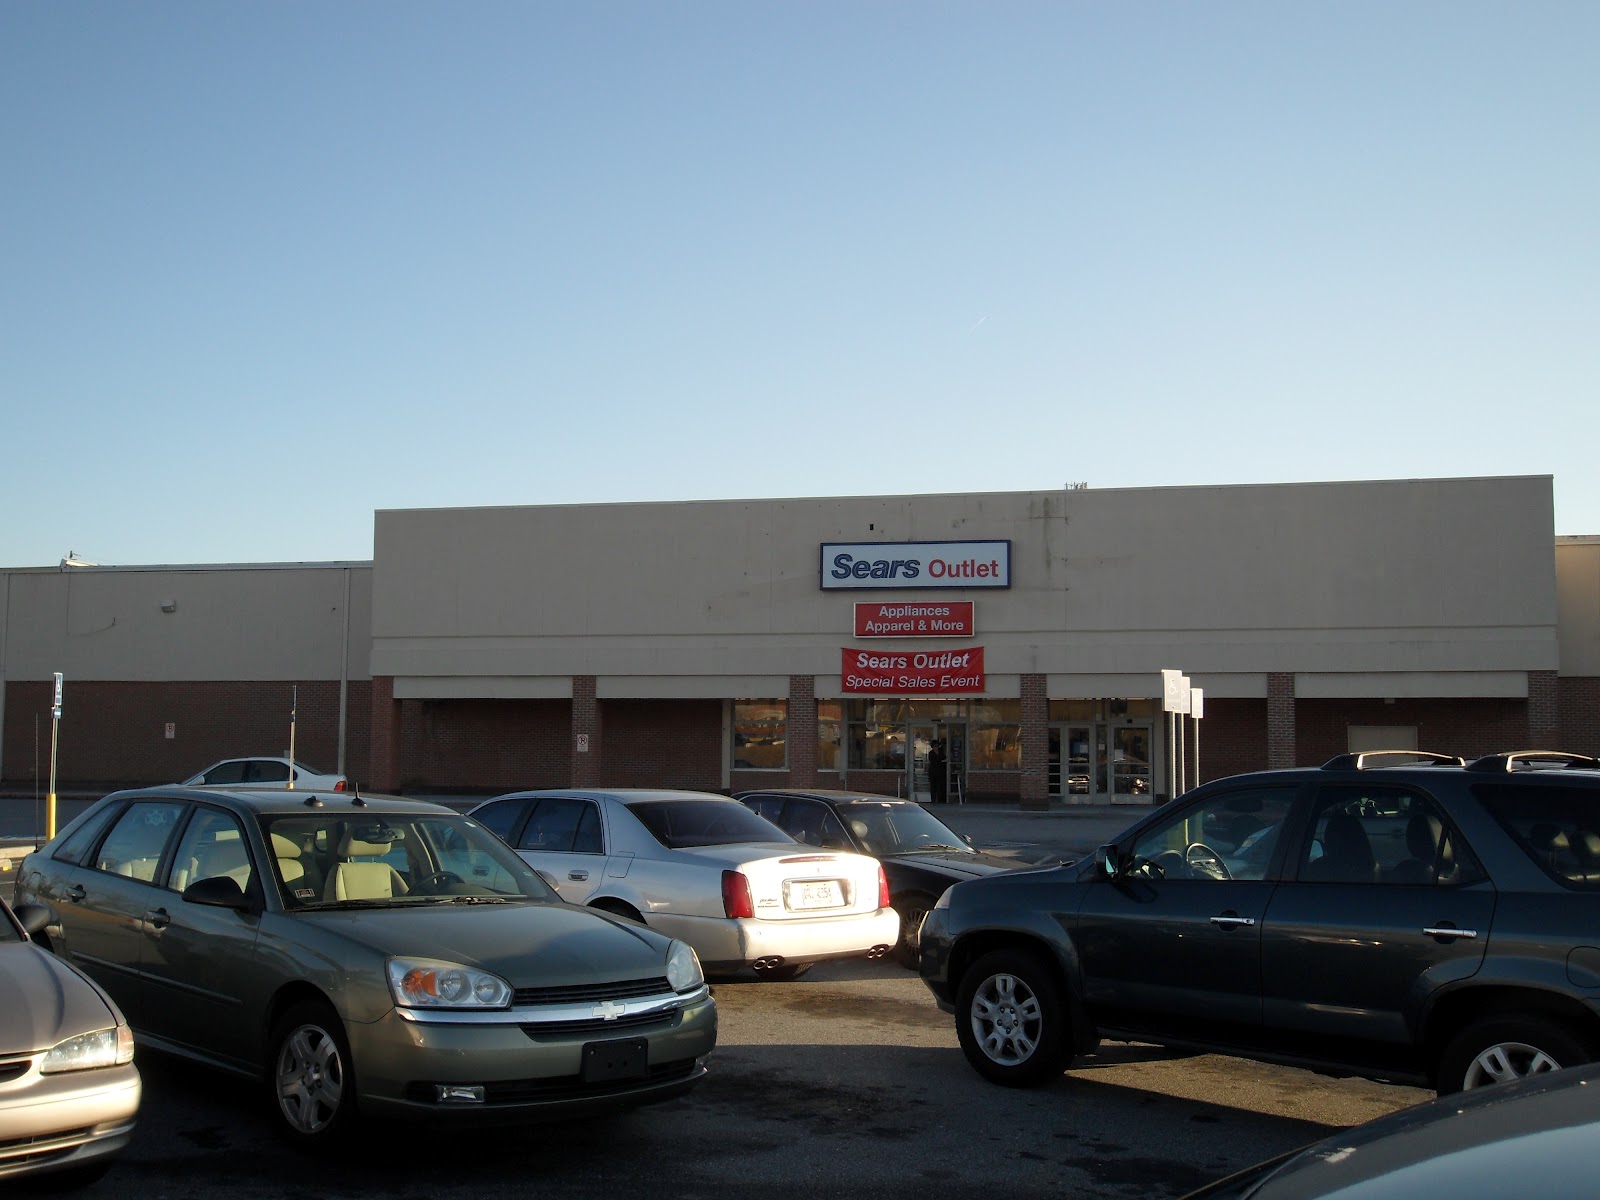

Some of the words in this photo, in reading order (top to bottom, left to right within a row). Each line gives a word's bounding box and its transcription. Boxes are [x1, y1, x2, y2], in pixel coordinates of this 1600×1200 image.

[831, 553, 921, 580] Sears
[928, 559, 999, 579] Outlet
[879, 605, 950, 619] Appliances
[865, 620, 914, 634] Apparel
[917, 620, 927, 631] &
[931, 619, 964, 631] More
[856, 652, 907, 669] Sears
[913, 652, 970, 668] Outlet
[845, 674, 894, 689] Special
[897, 676, 936, 688] Sales
[940, 675, 980, 687] Event
